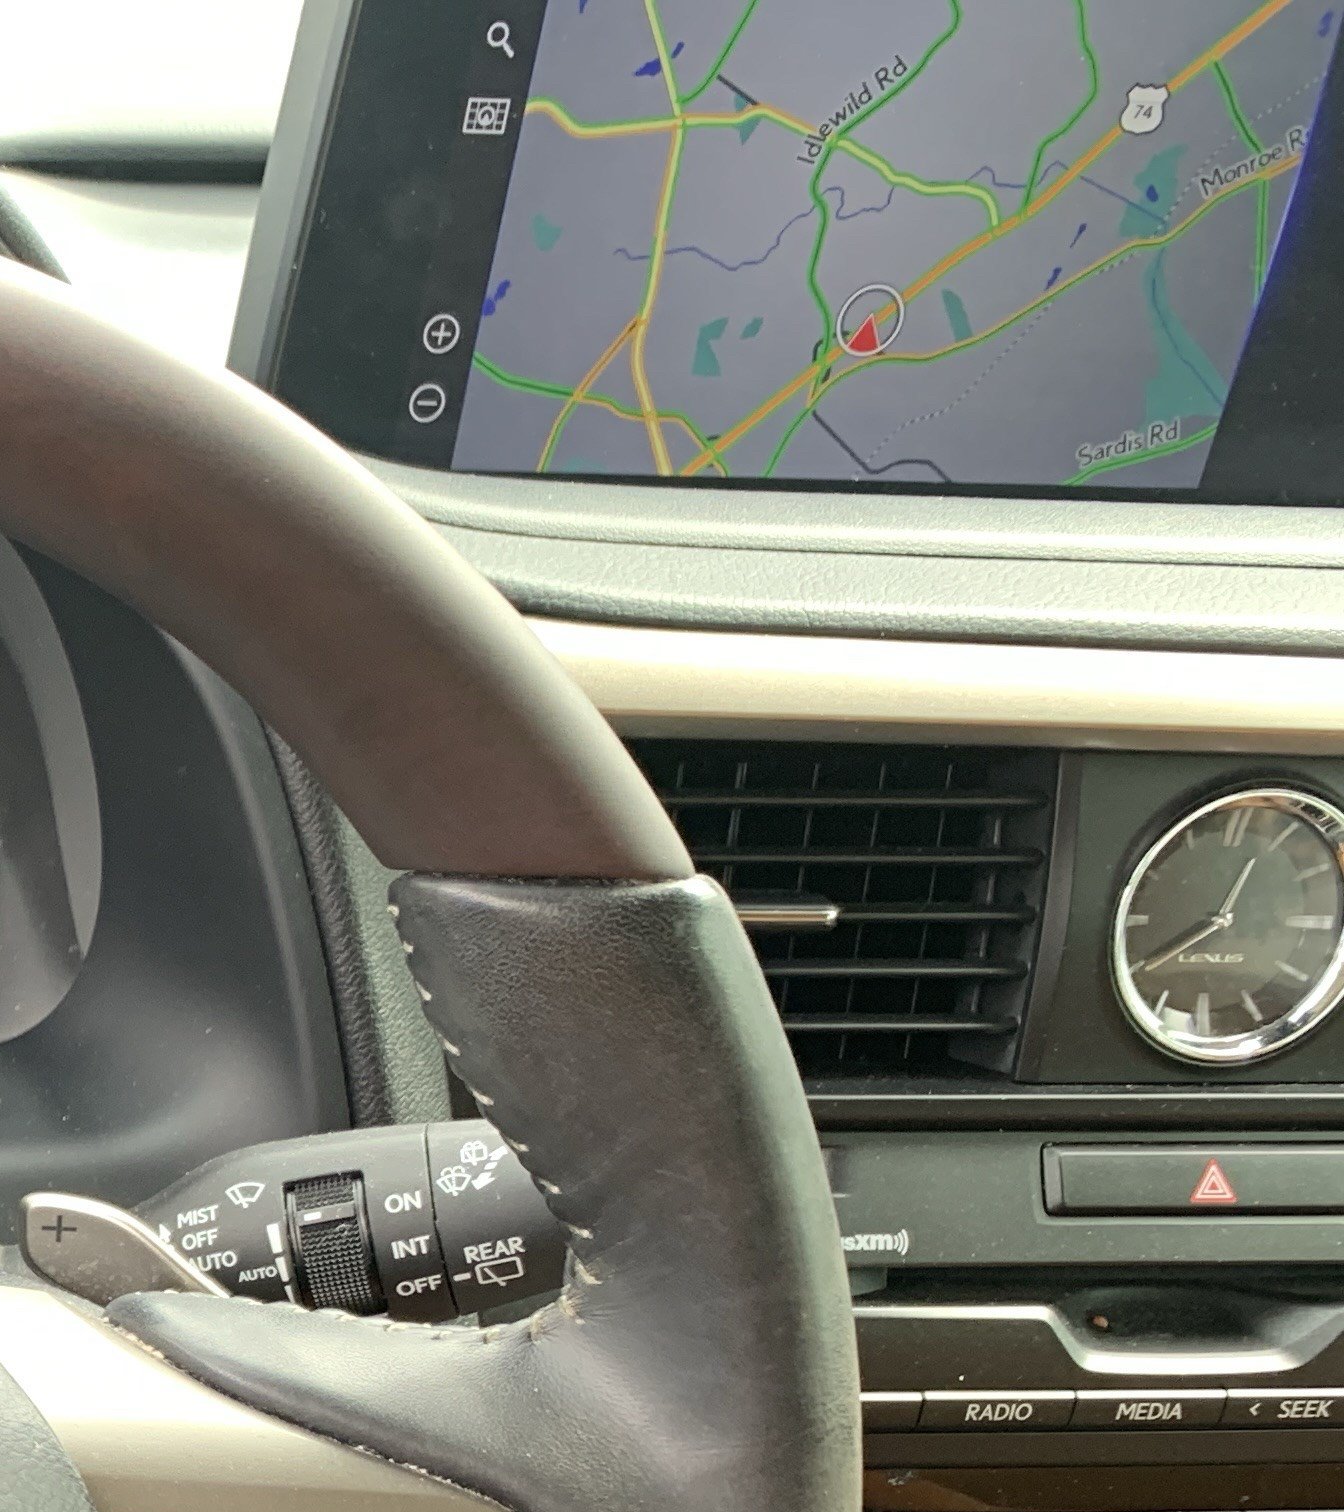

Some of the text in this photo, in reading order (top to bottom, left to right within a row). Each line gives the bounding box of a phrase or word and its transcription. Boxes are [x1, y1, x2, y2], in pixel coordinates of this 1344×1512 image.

[797, 54, 908, 165] Idlewild Rd
[1134, 104, 1153, 120] 74
[1200, 145, 1283, 197] Monroe
[1077, 420, 1179, 467] Sardis Rd
[1178, 952, 1245, 963] LEXUS
[384, 1191, 422, 1213] ON
[176, 1205, 219, 1228] MIST
[182, 1228, 219, 1251] OFF
[391, 1235, 430, 1259] INT
[463, 1236, 526, 1264] REAR
[238, 1265, 278, 1283] AUTO
[395, 1274, 443, 1297] OFF
[964, 1402, 1033, 1421] RADIO
[1115, 1402, 1183, 1421] MEDIA
[1277, 1399, 1333, 1418] SEEK
